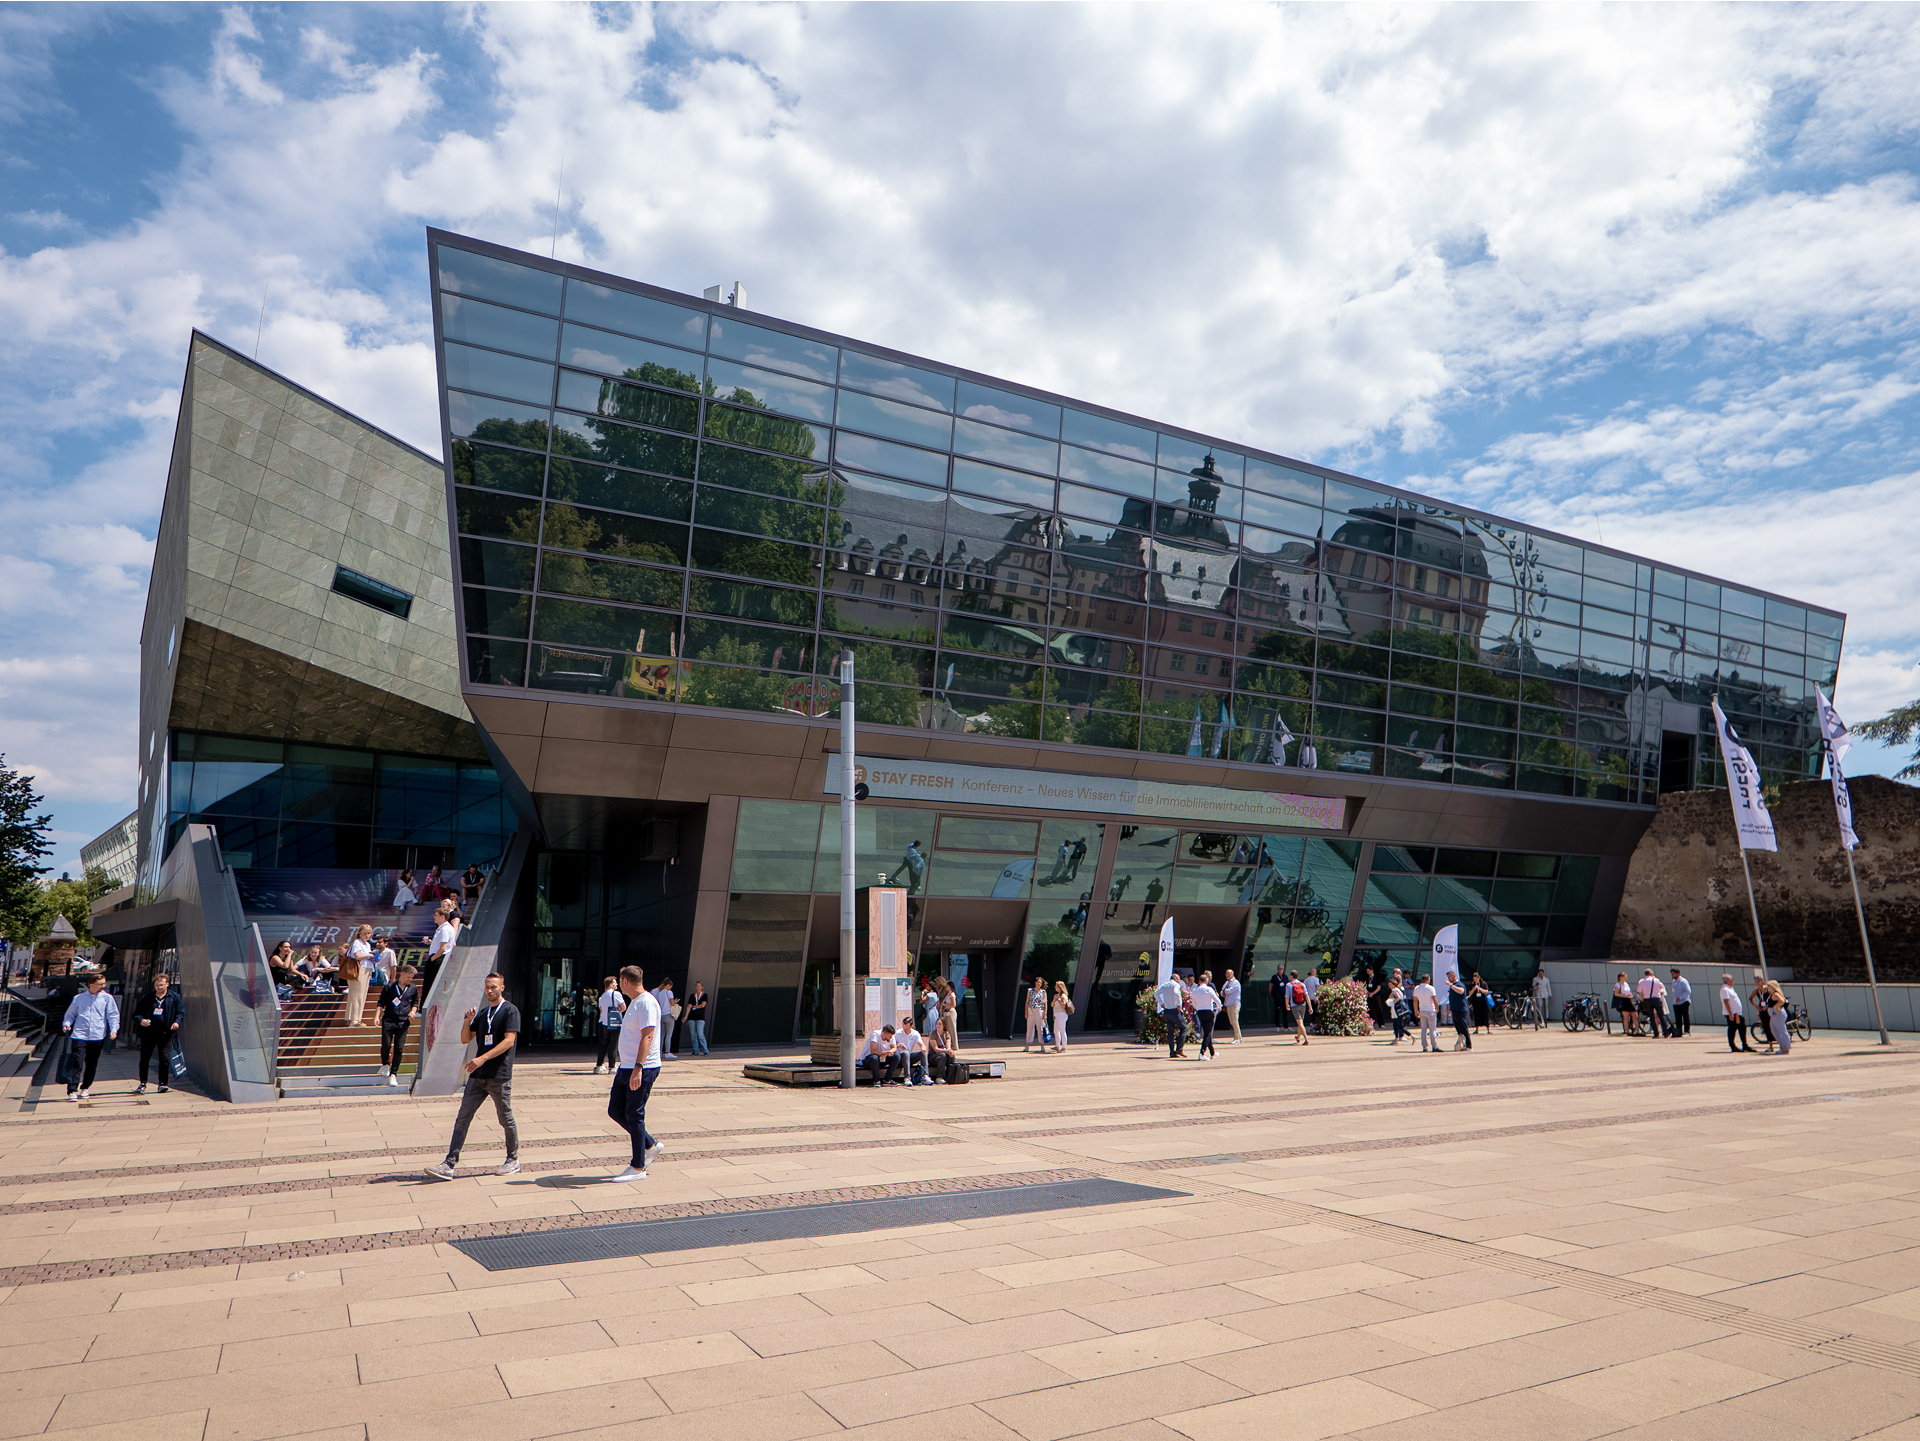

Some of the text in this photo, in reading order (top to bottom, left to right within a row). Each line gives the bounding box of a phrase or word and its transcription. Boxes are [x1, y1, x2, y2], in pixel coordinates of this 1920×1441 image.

[871, 771, 907, 785] STAY
[910, 773, 954, 789] FRESH
[962, 778, 1023, 794] Konferenz
[1037, 784, 1074, 798] Neues
[1077, 787, 1116, 801] Wissen
[1120, 790, 1135, 803] für
[1138, 793, 1153, 804] die
[1266, 806, 1281, 814] am
[1284, 805, 1332, 818] 02.07.2026
[287, 926, 341, 944] HIER
[1173, 938, 1197, 947] ngang
